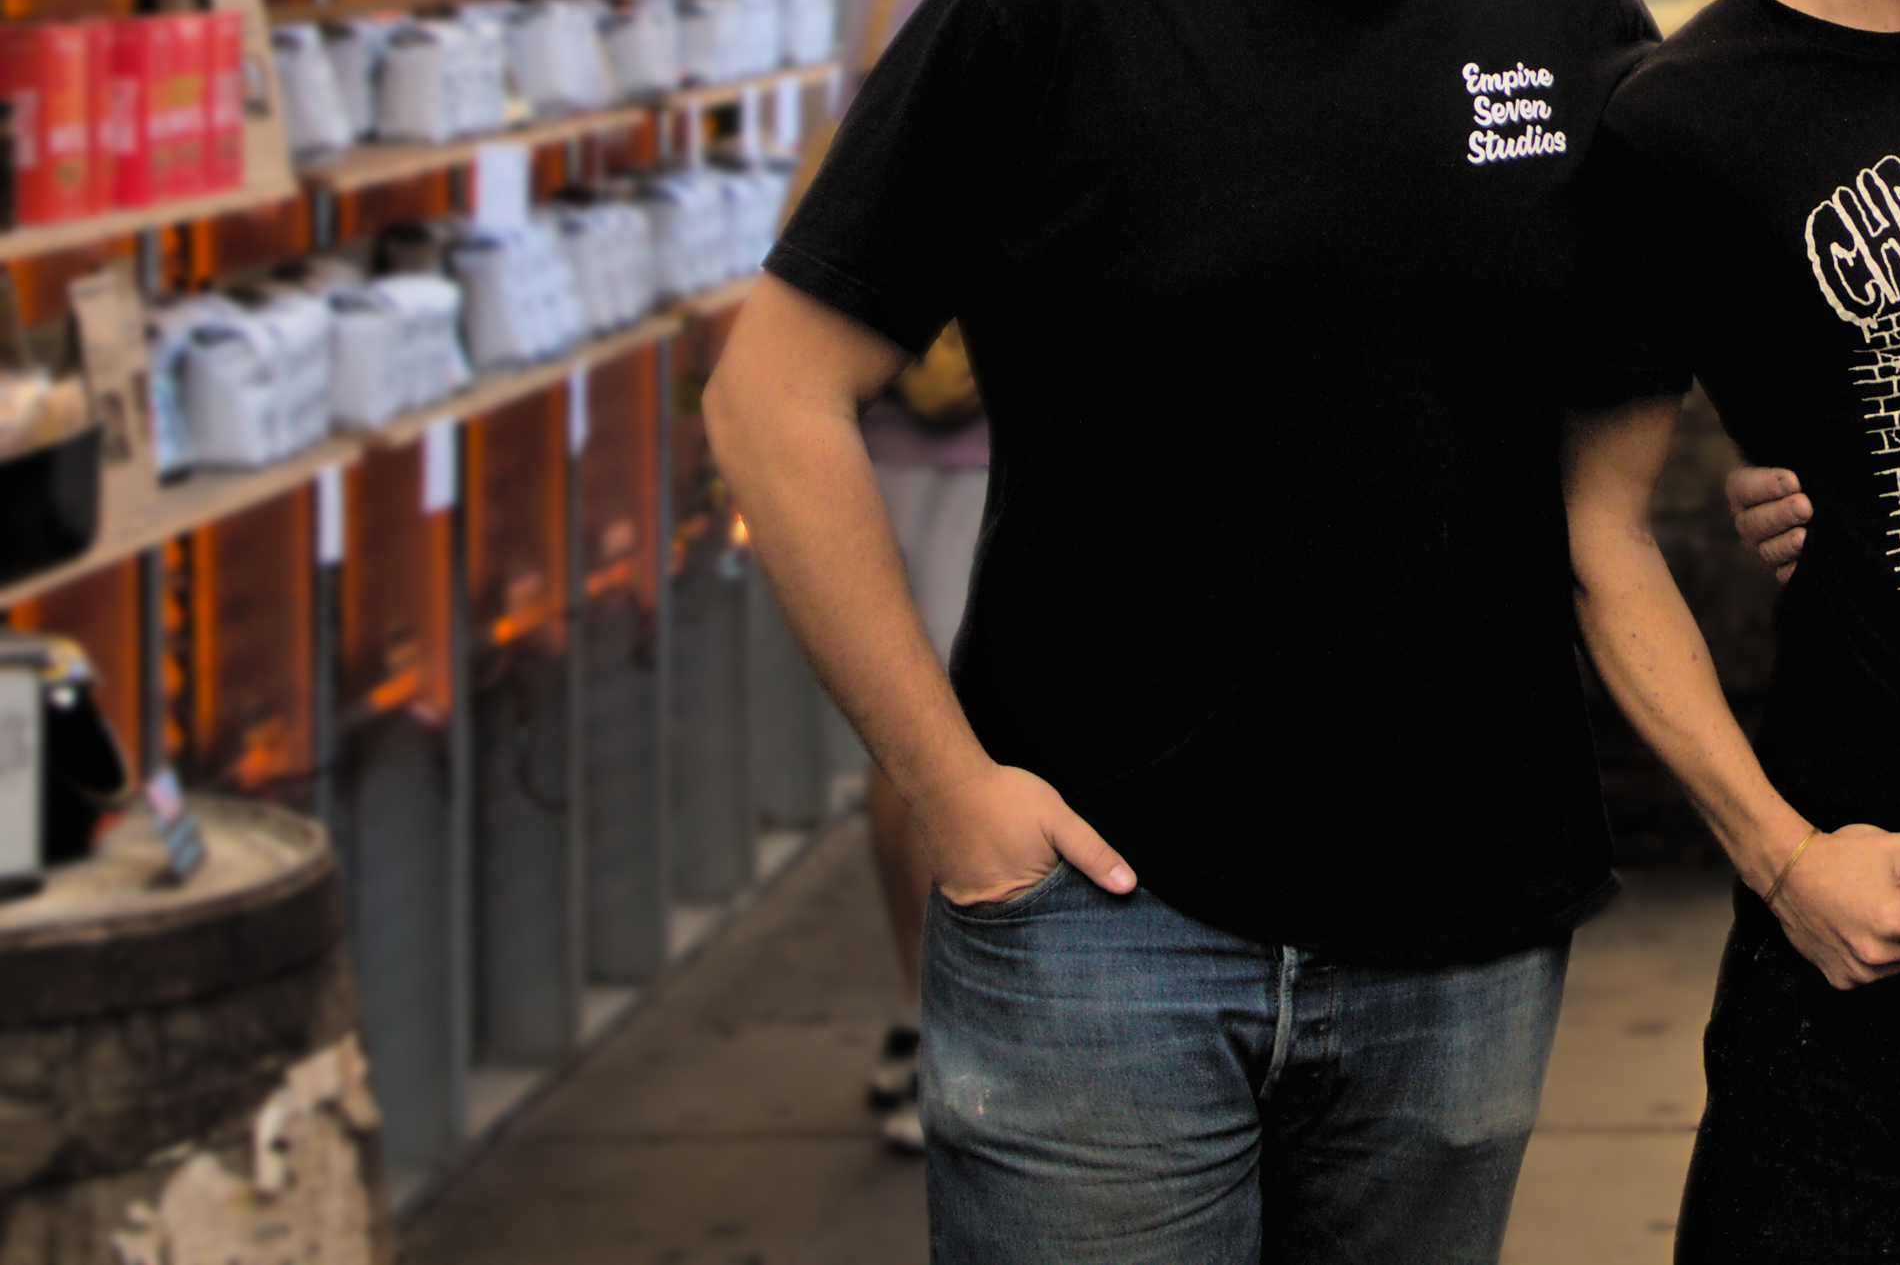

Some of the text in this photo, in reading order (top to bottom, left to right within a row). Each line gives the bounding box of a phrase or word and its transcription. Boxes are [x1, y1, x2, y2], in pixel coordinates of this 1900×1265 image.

[1462, 62, 1554, 96] Empire
[1473, 95, 1552, 127] Seven
[1467, 125, 1567, 165] Studios
